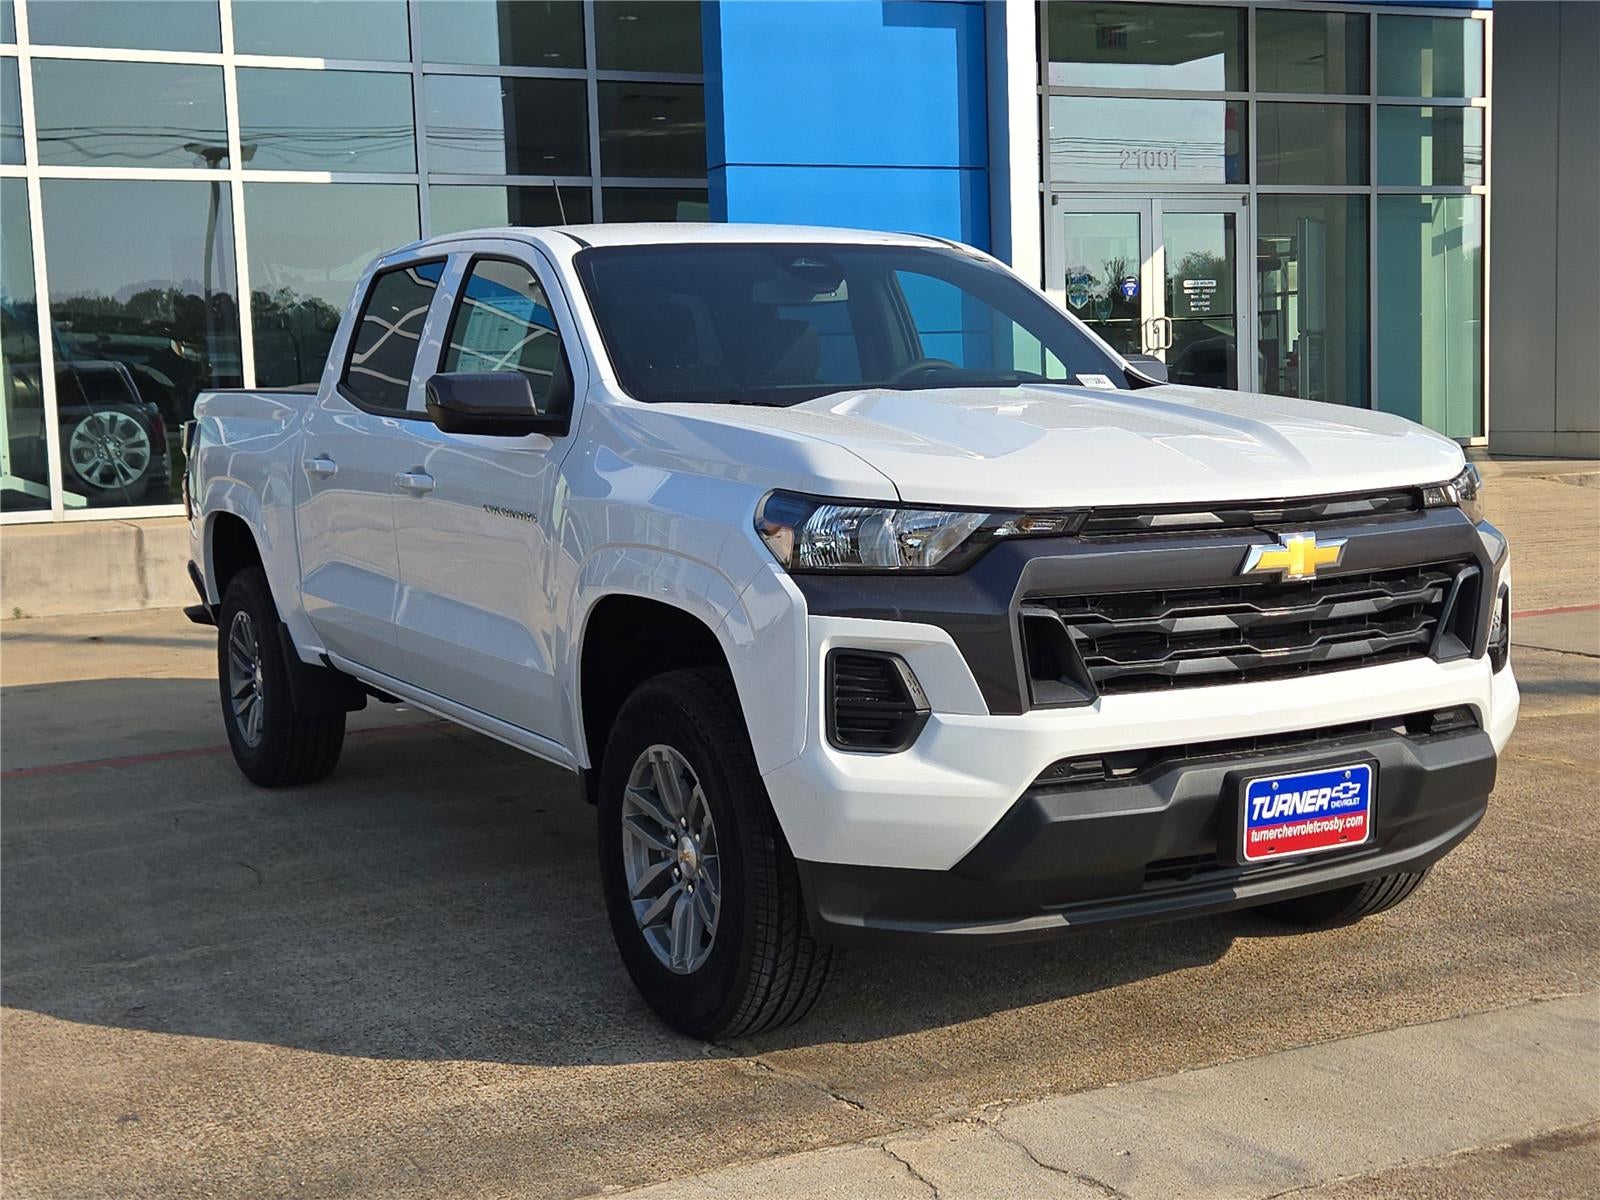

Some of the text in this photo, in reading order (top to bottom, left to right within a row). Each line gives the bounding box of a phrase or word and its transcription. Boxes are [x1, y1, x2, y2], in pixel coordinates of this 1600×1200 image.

[1119, 148, 1178, 170] 21001
[1252, 787, 1332, 821] TURNER
[1330, 797, 1360, 809] CHEVROLET
[1251, 814, 1364, 843] turnerchevroletcrosby.com
